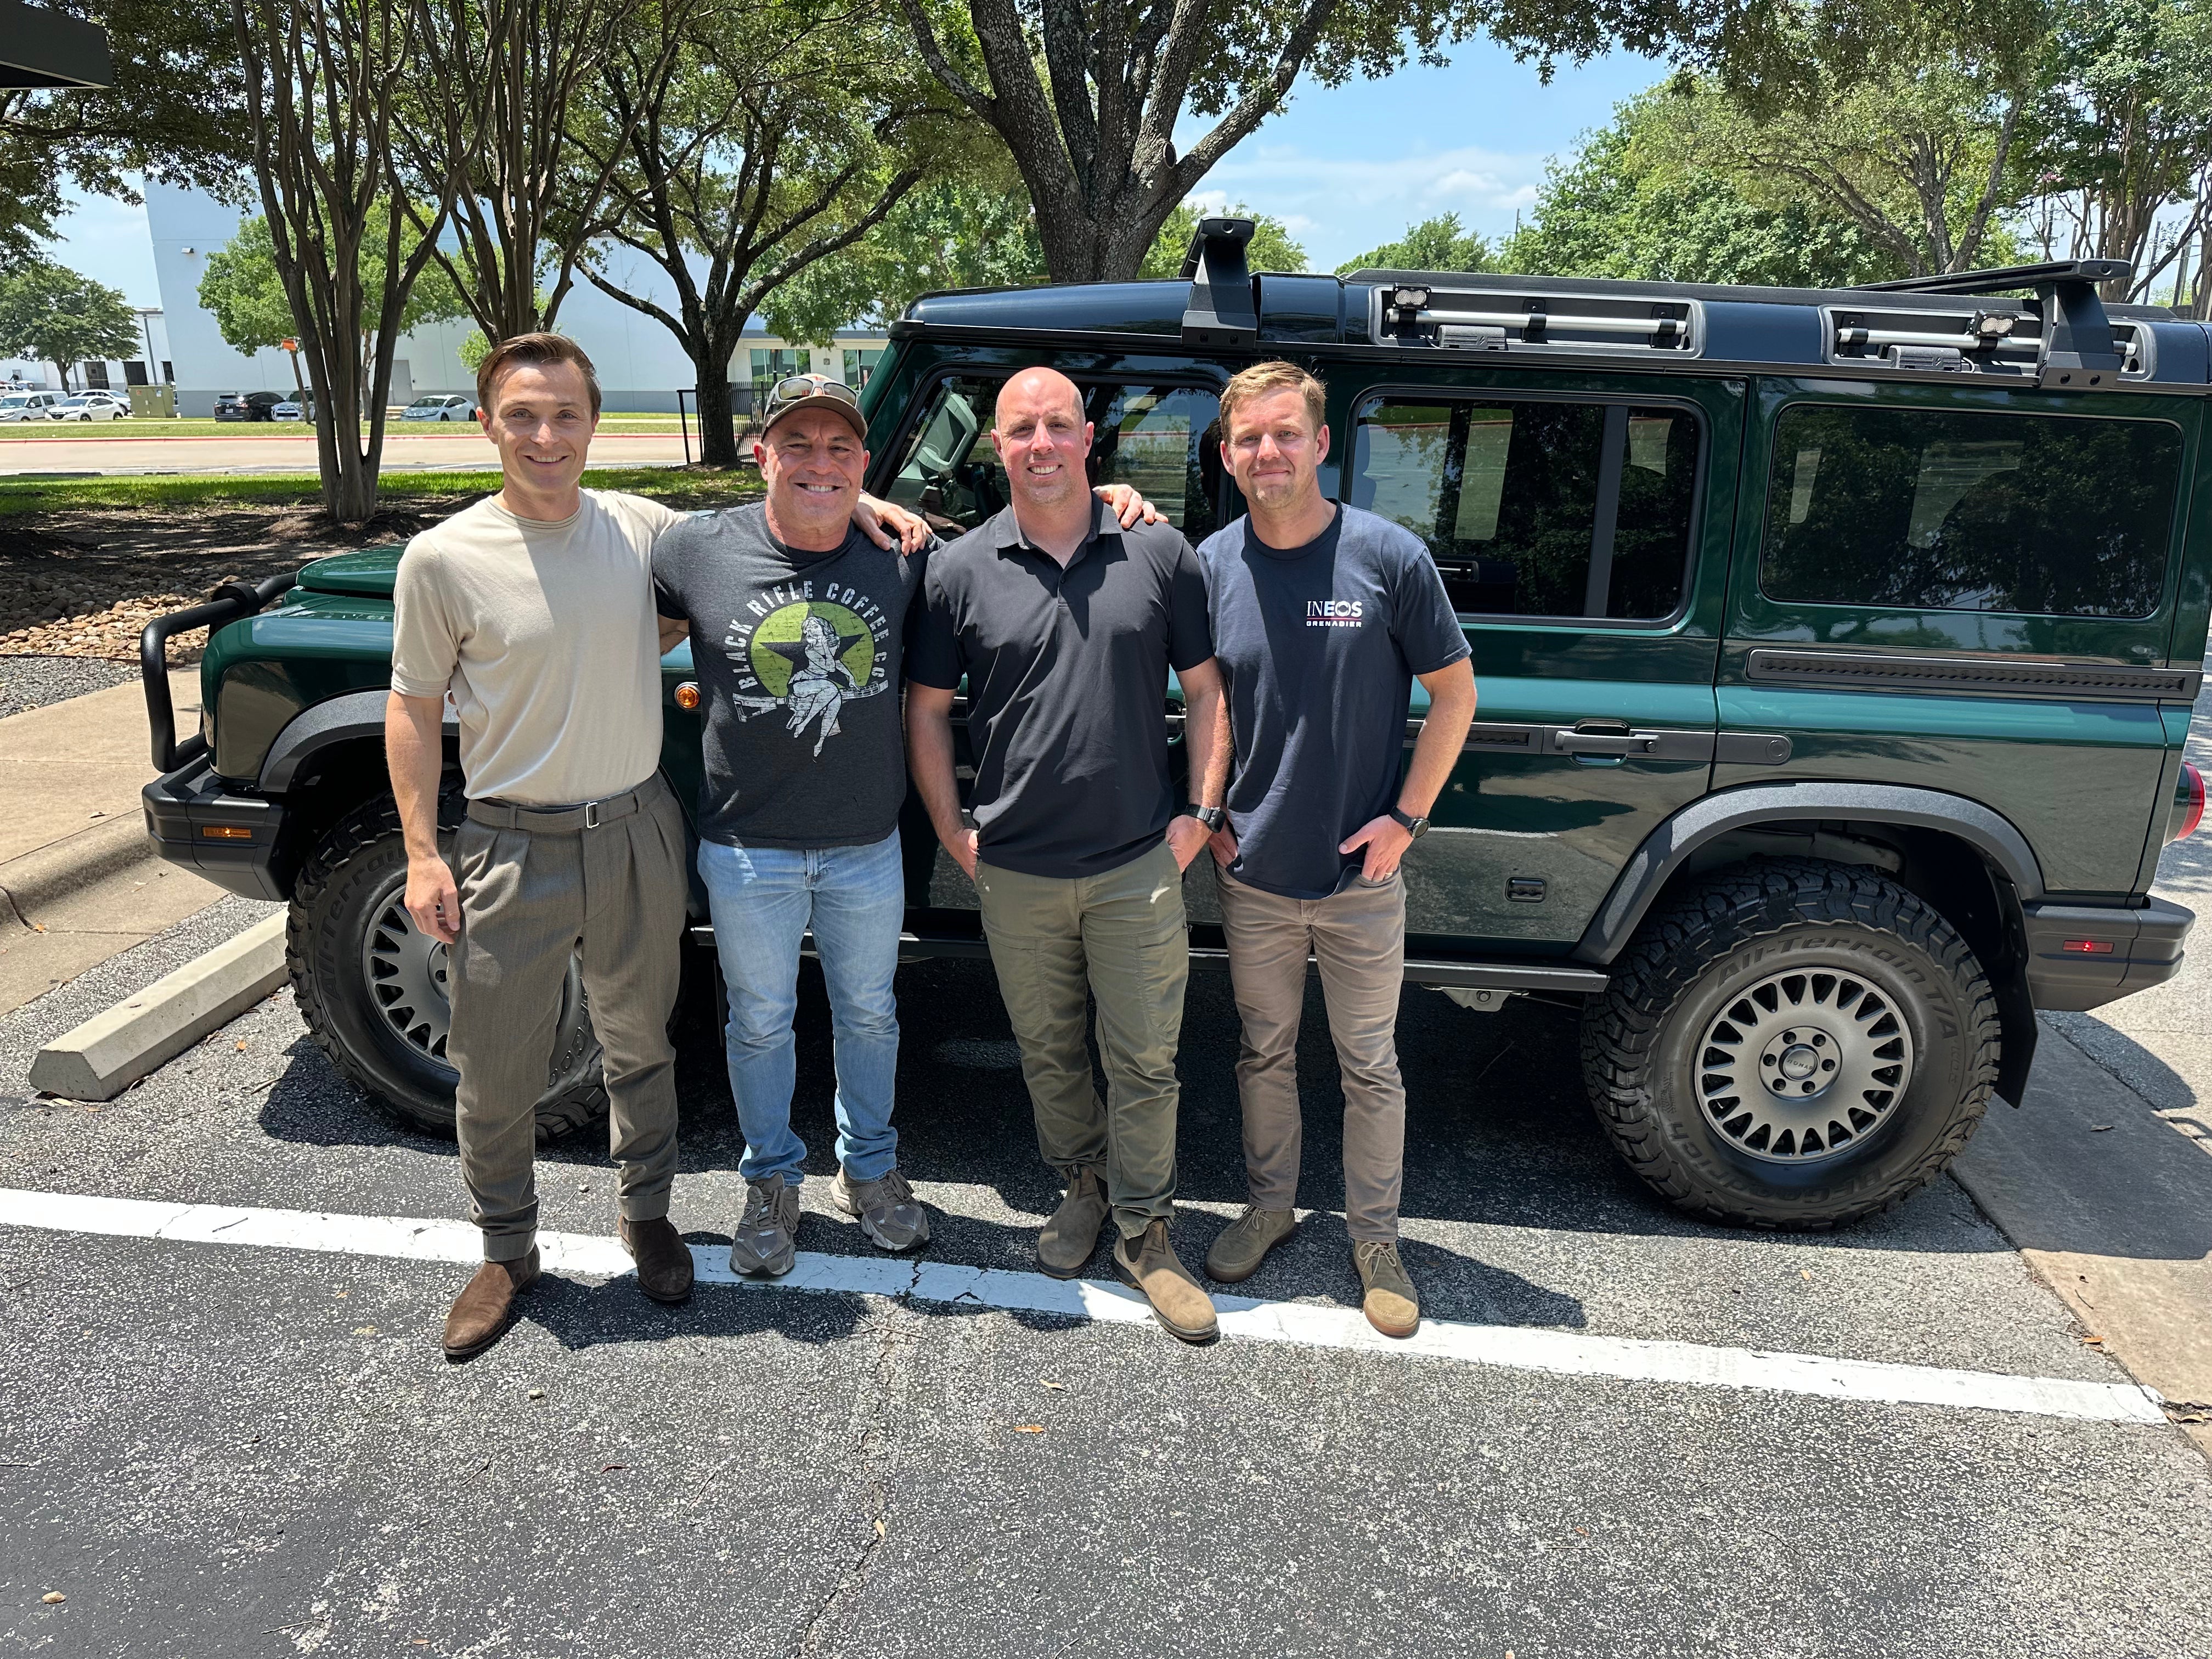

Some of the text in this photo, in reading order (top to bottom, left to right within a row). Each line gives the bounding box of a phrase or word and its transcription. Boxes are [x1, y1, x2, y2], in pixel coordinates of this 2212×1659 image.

[725, 619, 758, 690] BLACK
[746, 580, 813, 617] RIFLE
[826, 582, 889, 642] COFFEE
[1307, 600, 1362, 617] INEOS
[1718, 935, 1926, 988] All-Terrain
[1925, 985, 1959, 1040] T/A
